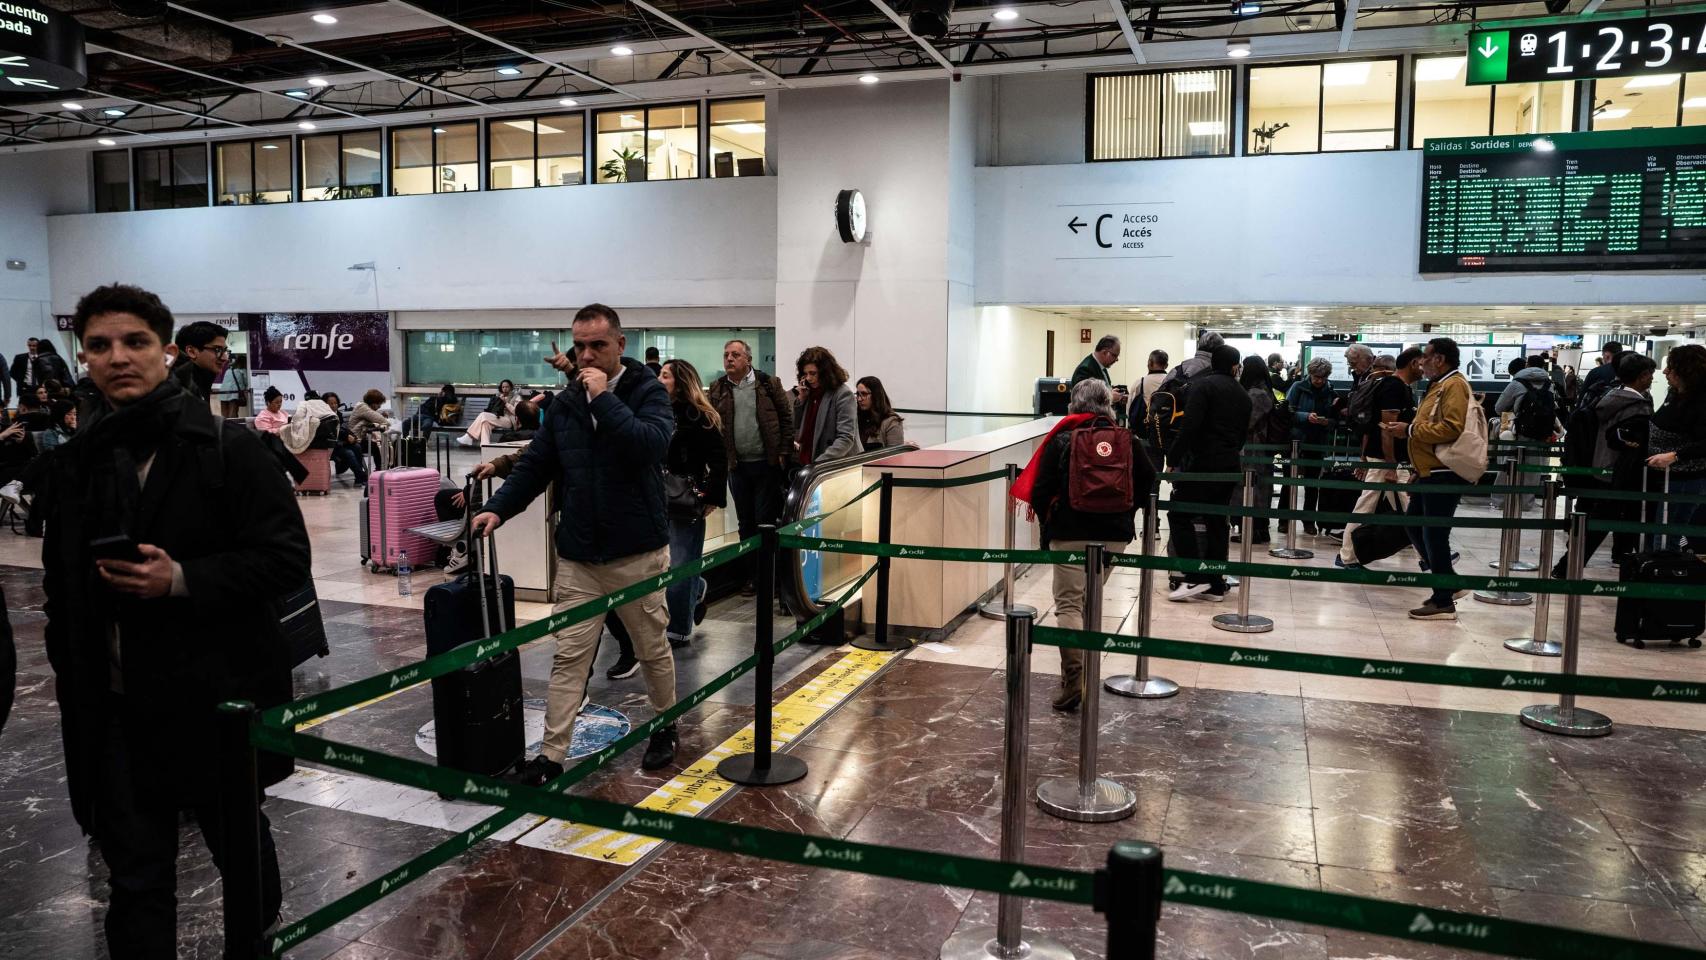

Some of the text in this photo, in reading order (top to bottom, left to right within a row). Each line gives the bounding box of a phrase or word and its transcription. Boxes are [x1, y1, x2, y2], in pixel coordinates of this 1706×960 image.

[1429, 142, 1463, 152] Salidas
[1470, 140, 1510, 150] Sortides
[1122, 213, 1159, 224] Acceso
[1095, 213, 1113, 249] C
[1122, 226, 1152, 238] Accés
[1122, 241, 1144, 249] ACCESS
[215, 315, 238, 327] renfe
[283, 323, 354, 359] renfe
[1117, 639, 1143, 649] adif
[1243, 652, 1271, 663] adif
[399, 669, 419, 682] adif
[1376, 665, 1405, 675] adif
[1517, 676, 1547, 687] adif
[1668, 686, 1701, 697] adif
[294, 701, 318, 717] adif
[337, 752, 365, 765] adif
[479, 784, 510, 799] adif
[683, 778, 708, 795] aquí
[474, 822, 492, 837] adif
[639, 815, 675, 831] adif
[824, 848, 863, 863] adif
[389, 869, 410, 885] adif
[1033, 877, 1078, 891] adif
[1187, 880, 1238, 900] adif
[284, 923, 308, 944] adif
[1436, 919, 1491, 940] adif
